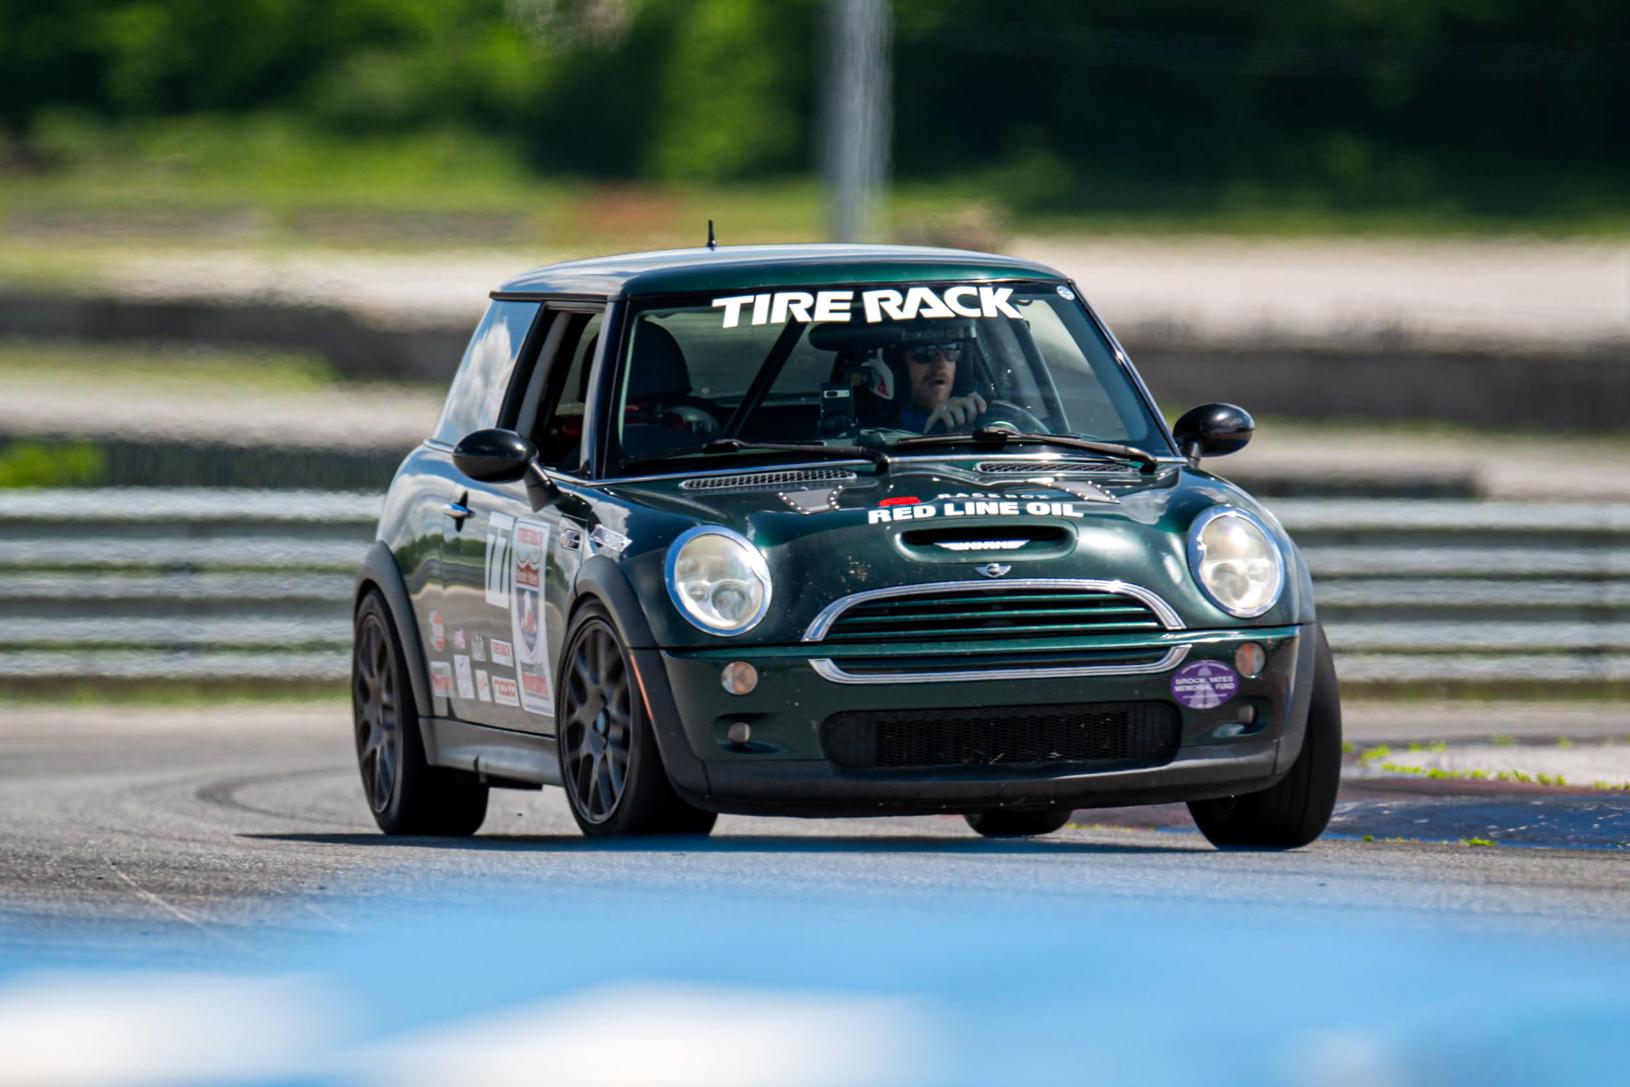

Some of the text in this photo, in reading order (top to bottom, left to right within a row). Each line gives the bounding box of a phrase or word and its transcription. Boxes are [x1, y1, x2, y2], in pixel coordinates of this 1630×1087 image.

[711, 286, 1023, 329] TIRE RACK
[868, 501, 1085, 525] RED LINE OIL
